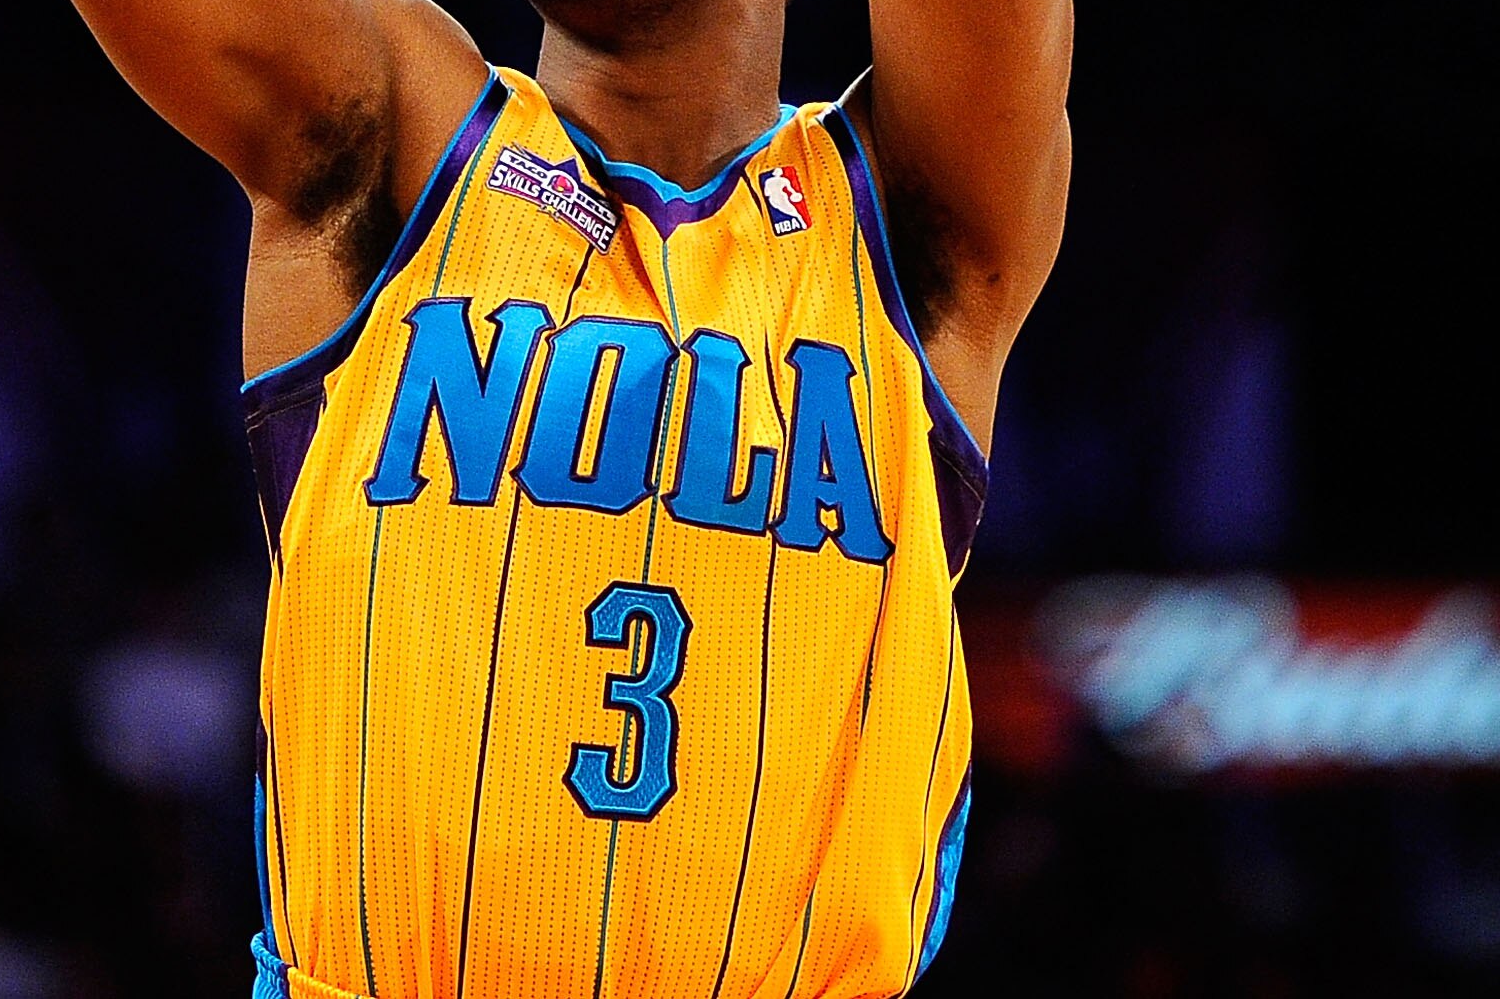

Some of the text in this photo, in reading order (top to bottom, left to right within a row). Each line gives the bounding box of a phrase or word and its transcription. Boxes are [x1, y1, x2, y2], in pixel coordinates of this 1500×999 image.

[489, 165, 613, 250] SKILLS CHALLENGE
[508, 155, 612, 222] TACO BELL
[774, 218, 801, 234] NBA
[363, 297, 896, 566] NOLA
[561, 580, 694, 823] 3
